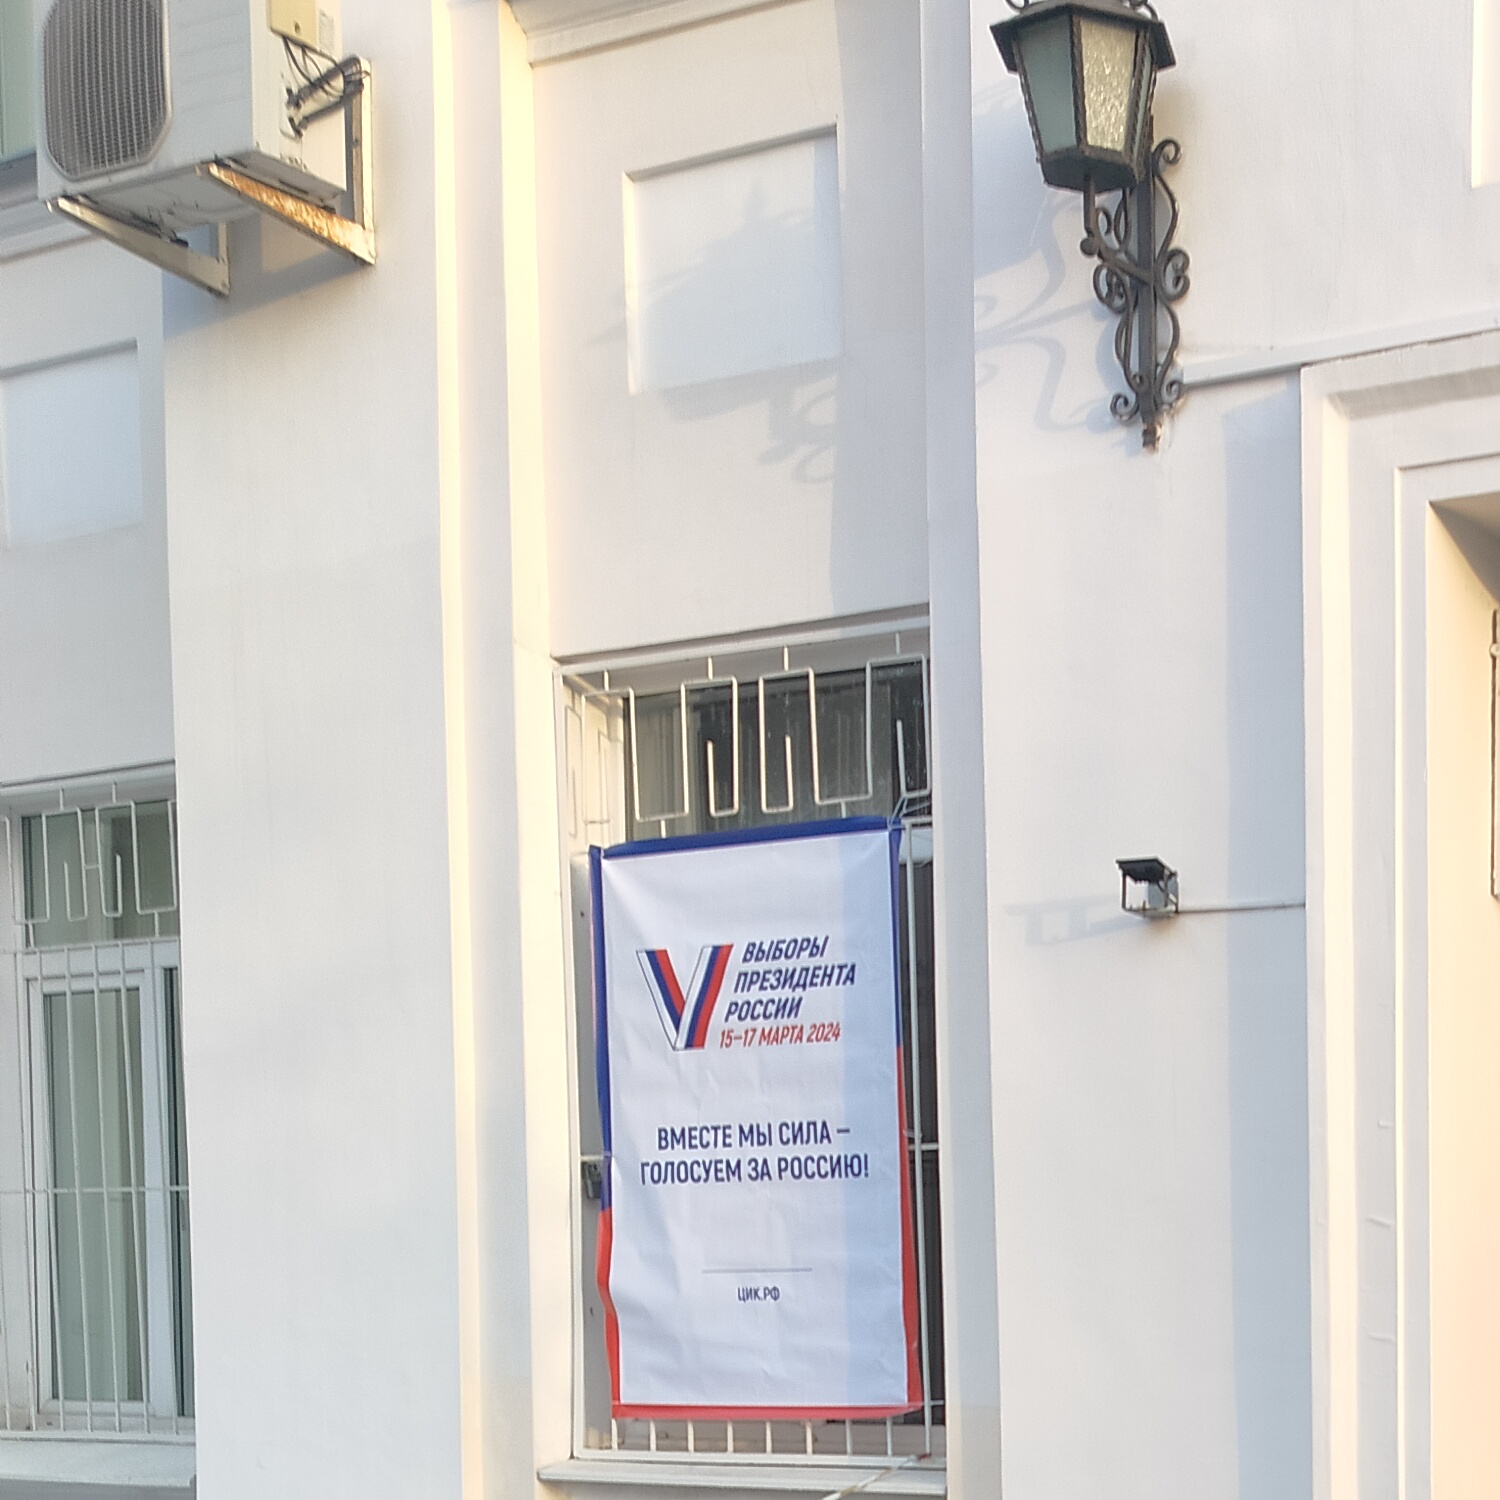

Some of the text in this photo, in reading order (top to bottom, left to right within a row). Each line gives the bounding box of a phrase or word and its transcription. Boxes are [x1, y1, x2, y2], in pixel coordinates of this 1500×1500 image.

[741, 935, 829, 964] ВЫБОРЫ
[733, 963, 857, 994] ПРЕЗИДЕНТА
[724, 996, 803, 1023] РОССИИ
[758, 1024, 804, 1047] МАРТА
[806, 1021, 841, 1044] 2024
[656, 1124, 732, 1151] ВМЕСТЕ
[738, 1122, 773, 1148] МЫ
[778, 1119, 832, 1145] СИЛА
[640, 1153, 870, 1186] ГОЛОСУЕМ ЗА РОССИЮ!
[737, 1286, 781, 1303] ЦИК.РФ
